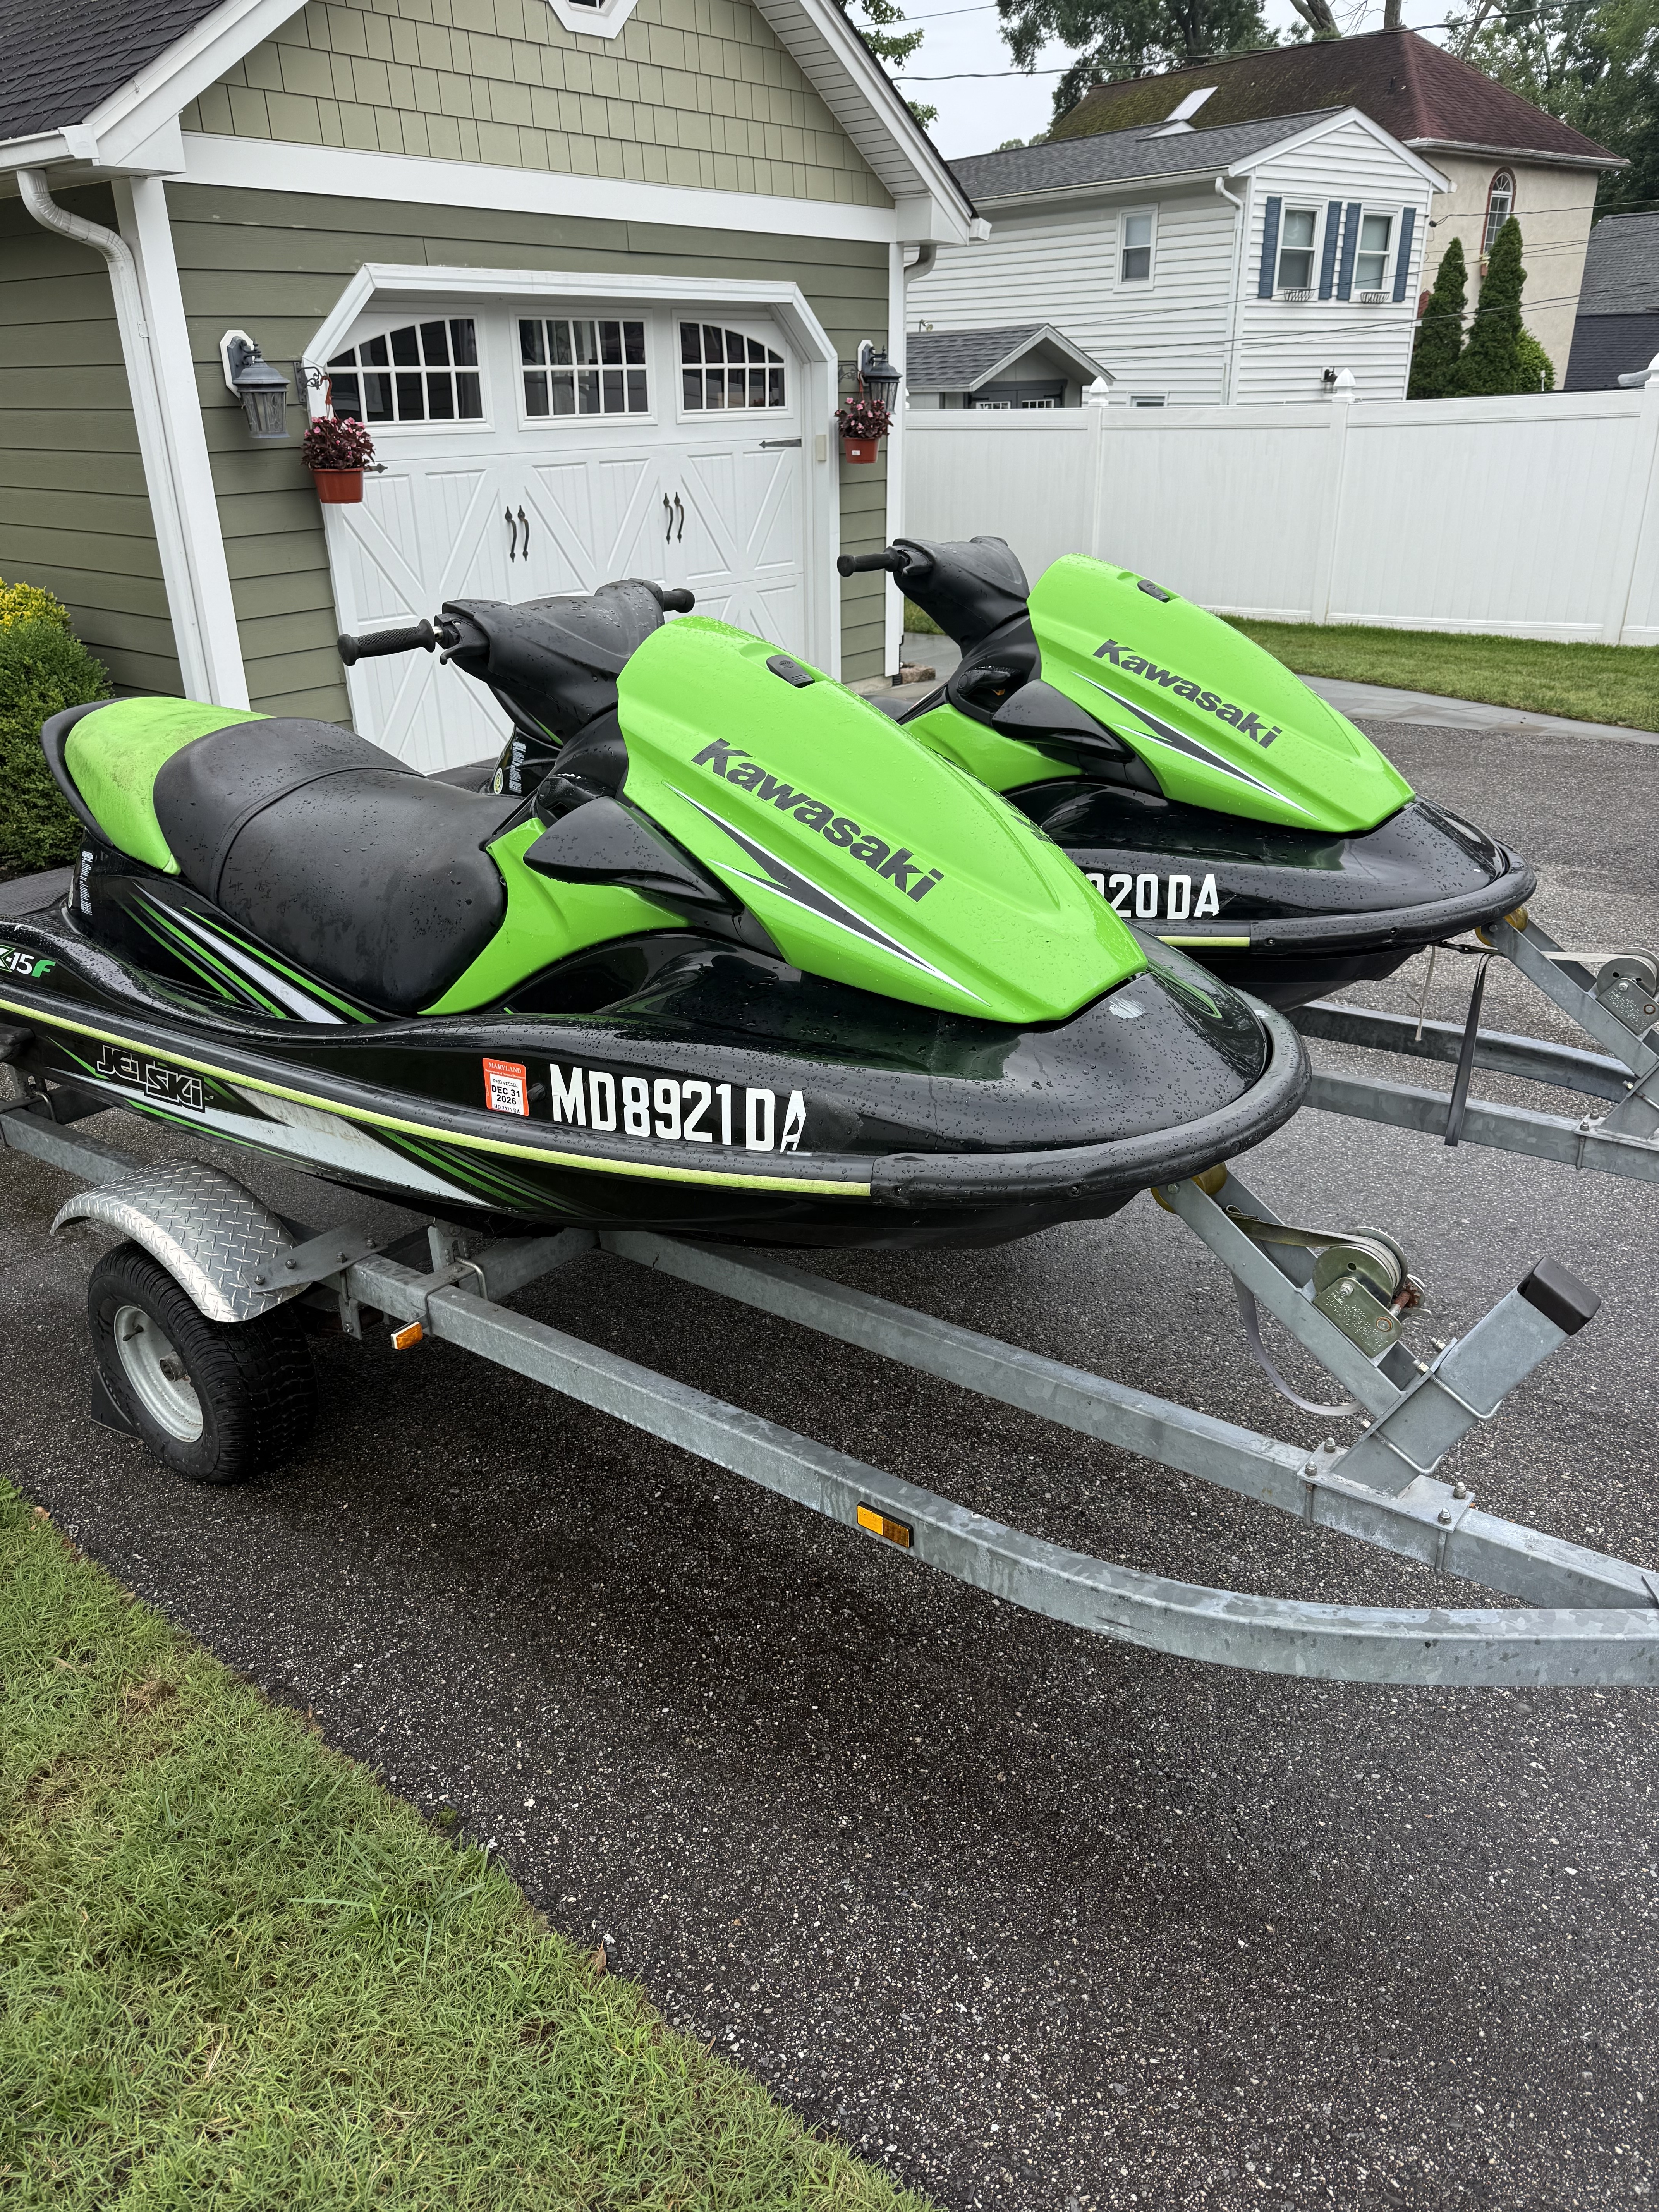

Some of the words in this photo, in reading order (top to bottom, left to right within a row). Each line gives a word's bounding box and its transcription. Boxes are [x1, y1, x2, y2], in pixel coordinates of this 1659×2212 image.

[1092, 639, 1282, 749] Kawasaki
[691, 738, 945, 902] Kawasaki
[488, 1062, 522, 1074] MARYLAND
[491, 1085, 508, 1095] DEC
[511, 1089, 520, 1098] 31
[496, 1094, 517, 1105] 2026
